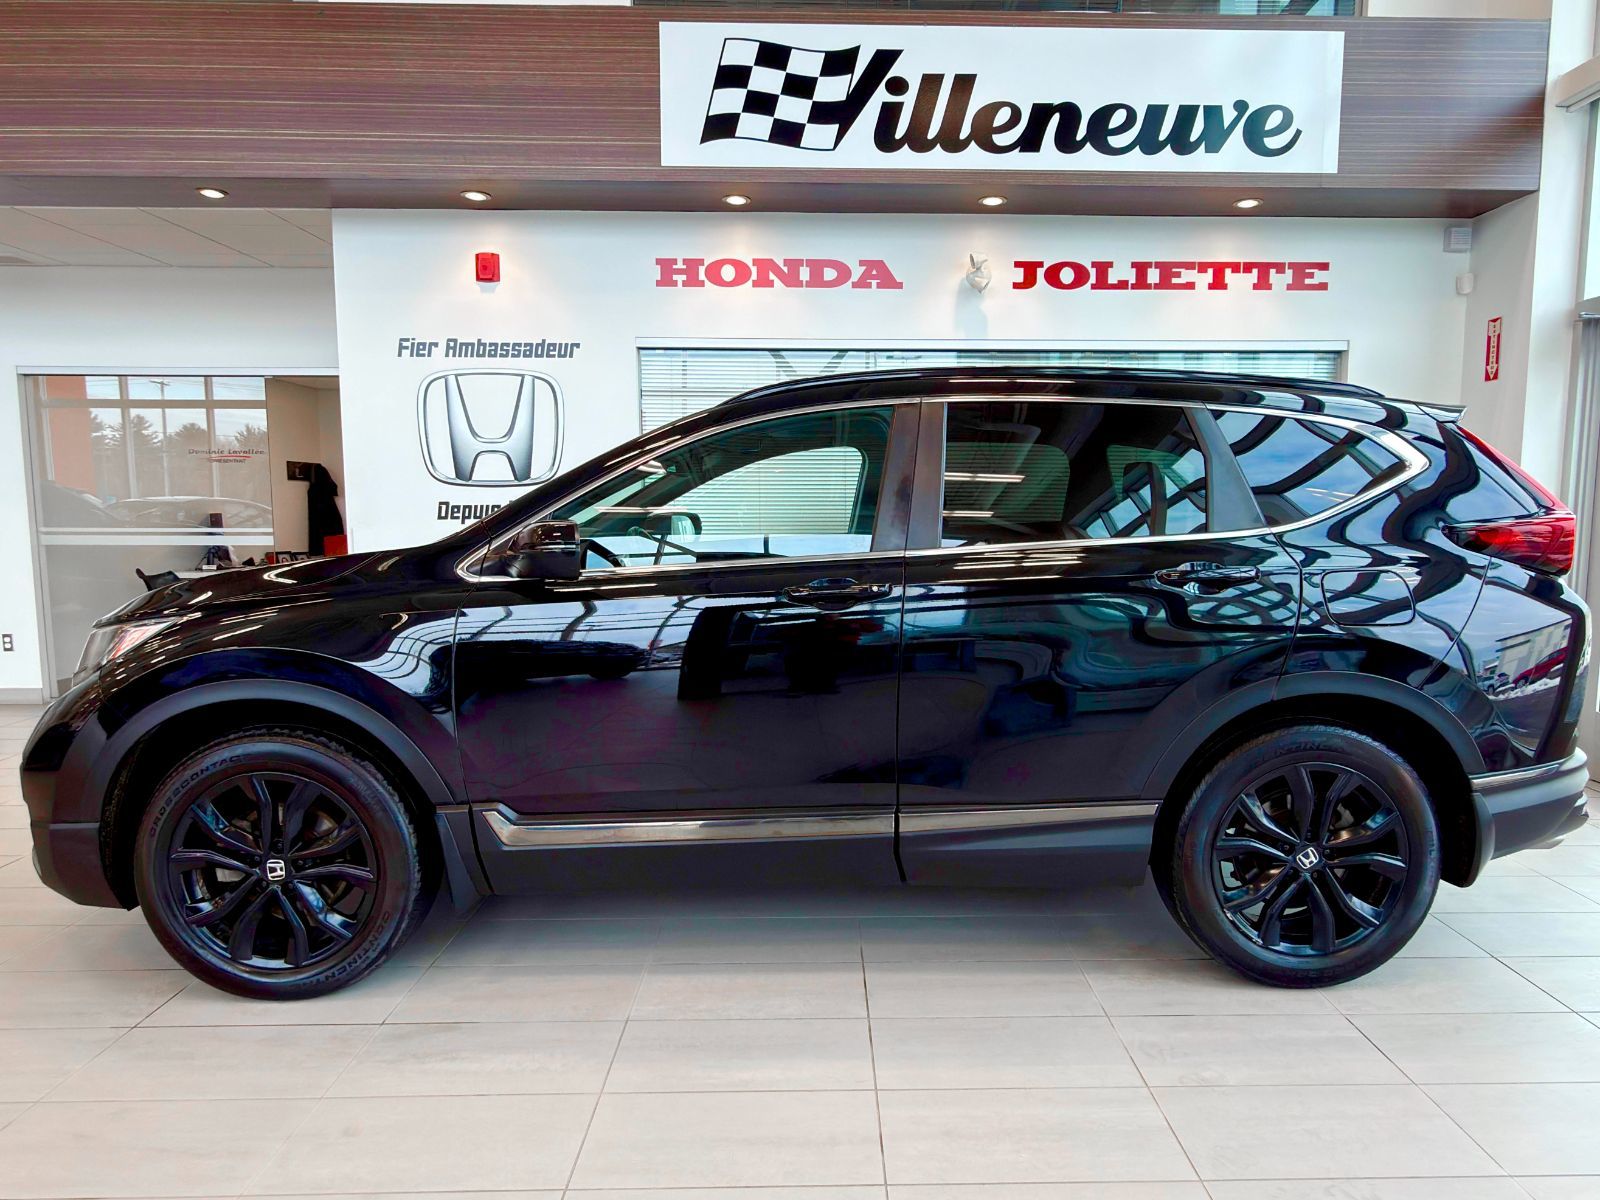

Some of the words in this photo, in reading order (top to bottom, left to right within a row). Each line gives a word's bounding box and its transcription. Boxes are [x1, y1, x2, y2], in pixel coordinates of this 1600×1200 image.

[830, 47, 1303, 157] Villeneuve
[655, 257, 904, 289] HONDA
[1012, 260, 1331, 291] JOLIETTE
[397, 337, 440, 358] Fier
[444, 338, 581, 359] Ambassadeur
[149, 754, 248, 839] CROSSCONTAC
